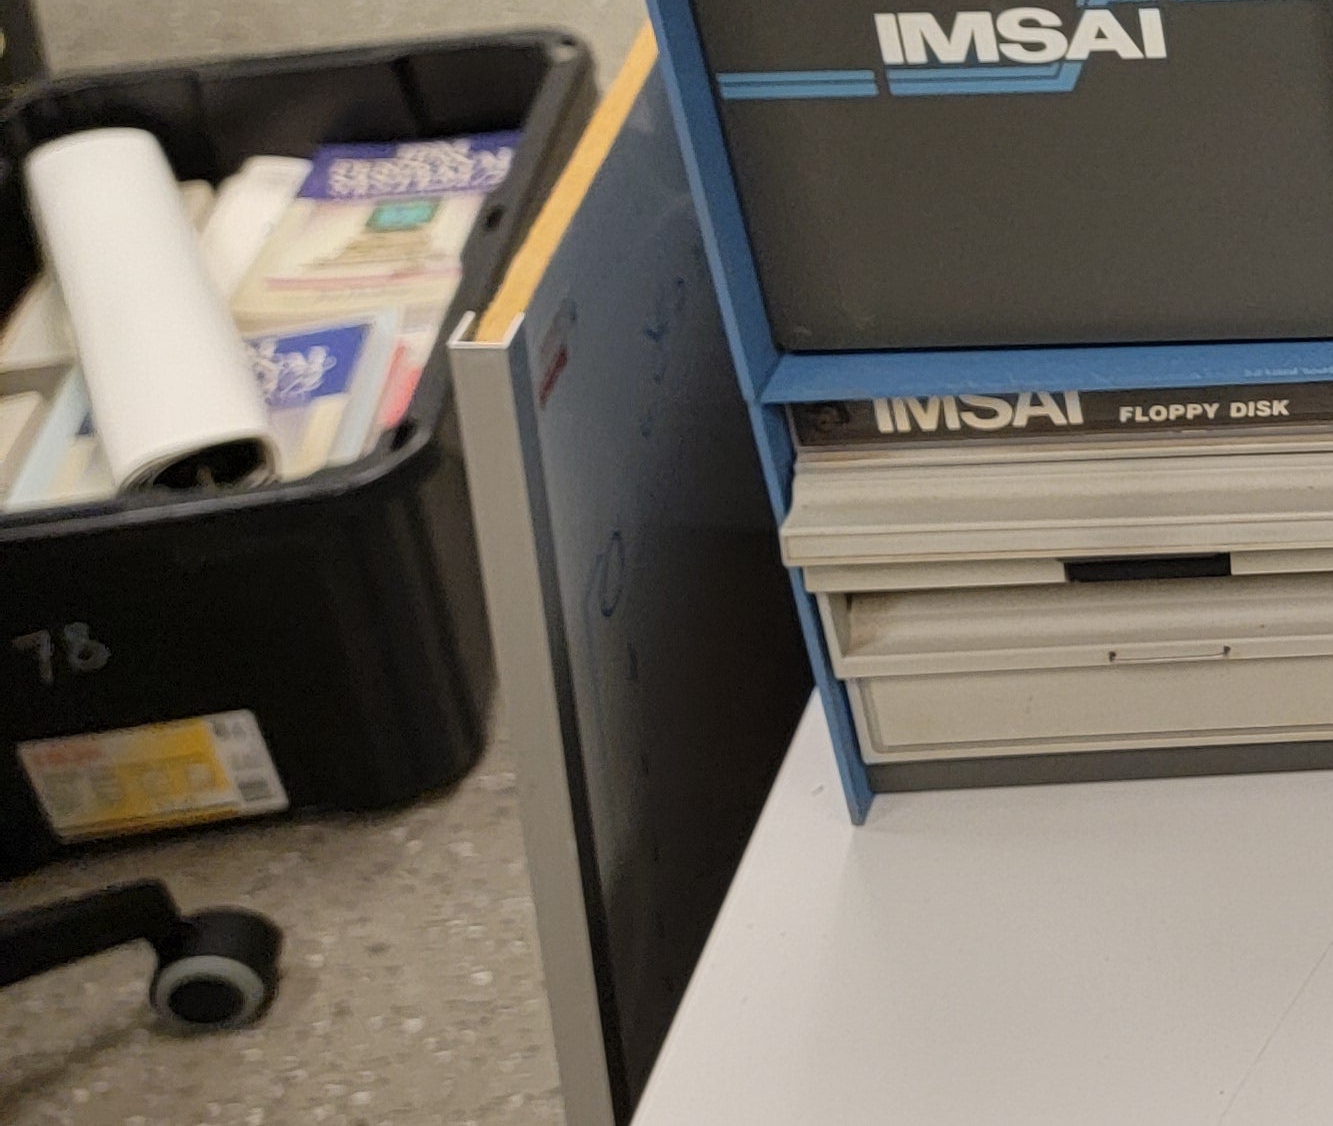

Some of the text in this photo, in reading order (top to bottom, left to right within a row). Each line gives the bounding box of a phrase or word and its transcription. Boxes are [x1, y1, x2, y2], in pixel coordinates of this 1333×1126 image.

[873, 7, 1168, 65] IMSAI
[872, 391, 1290, 433] IMSAI FLOPPY DISK
[10, 621, 113, 687] 78
